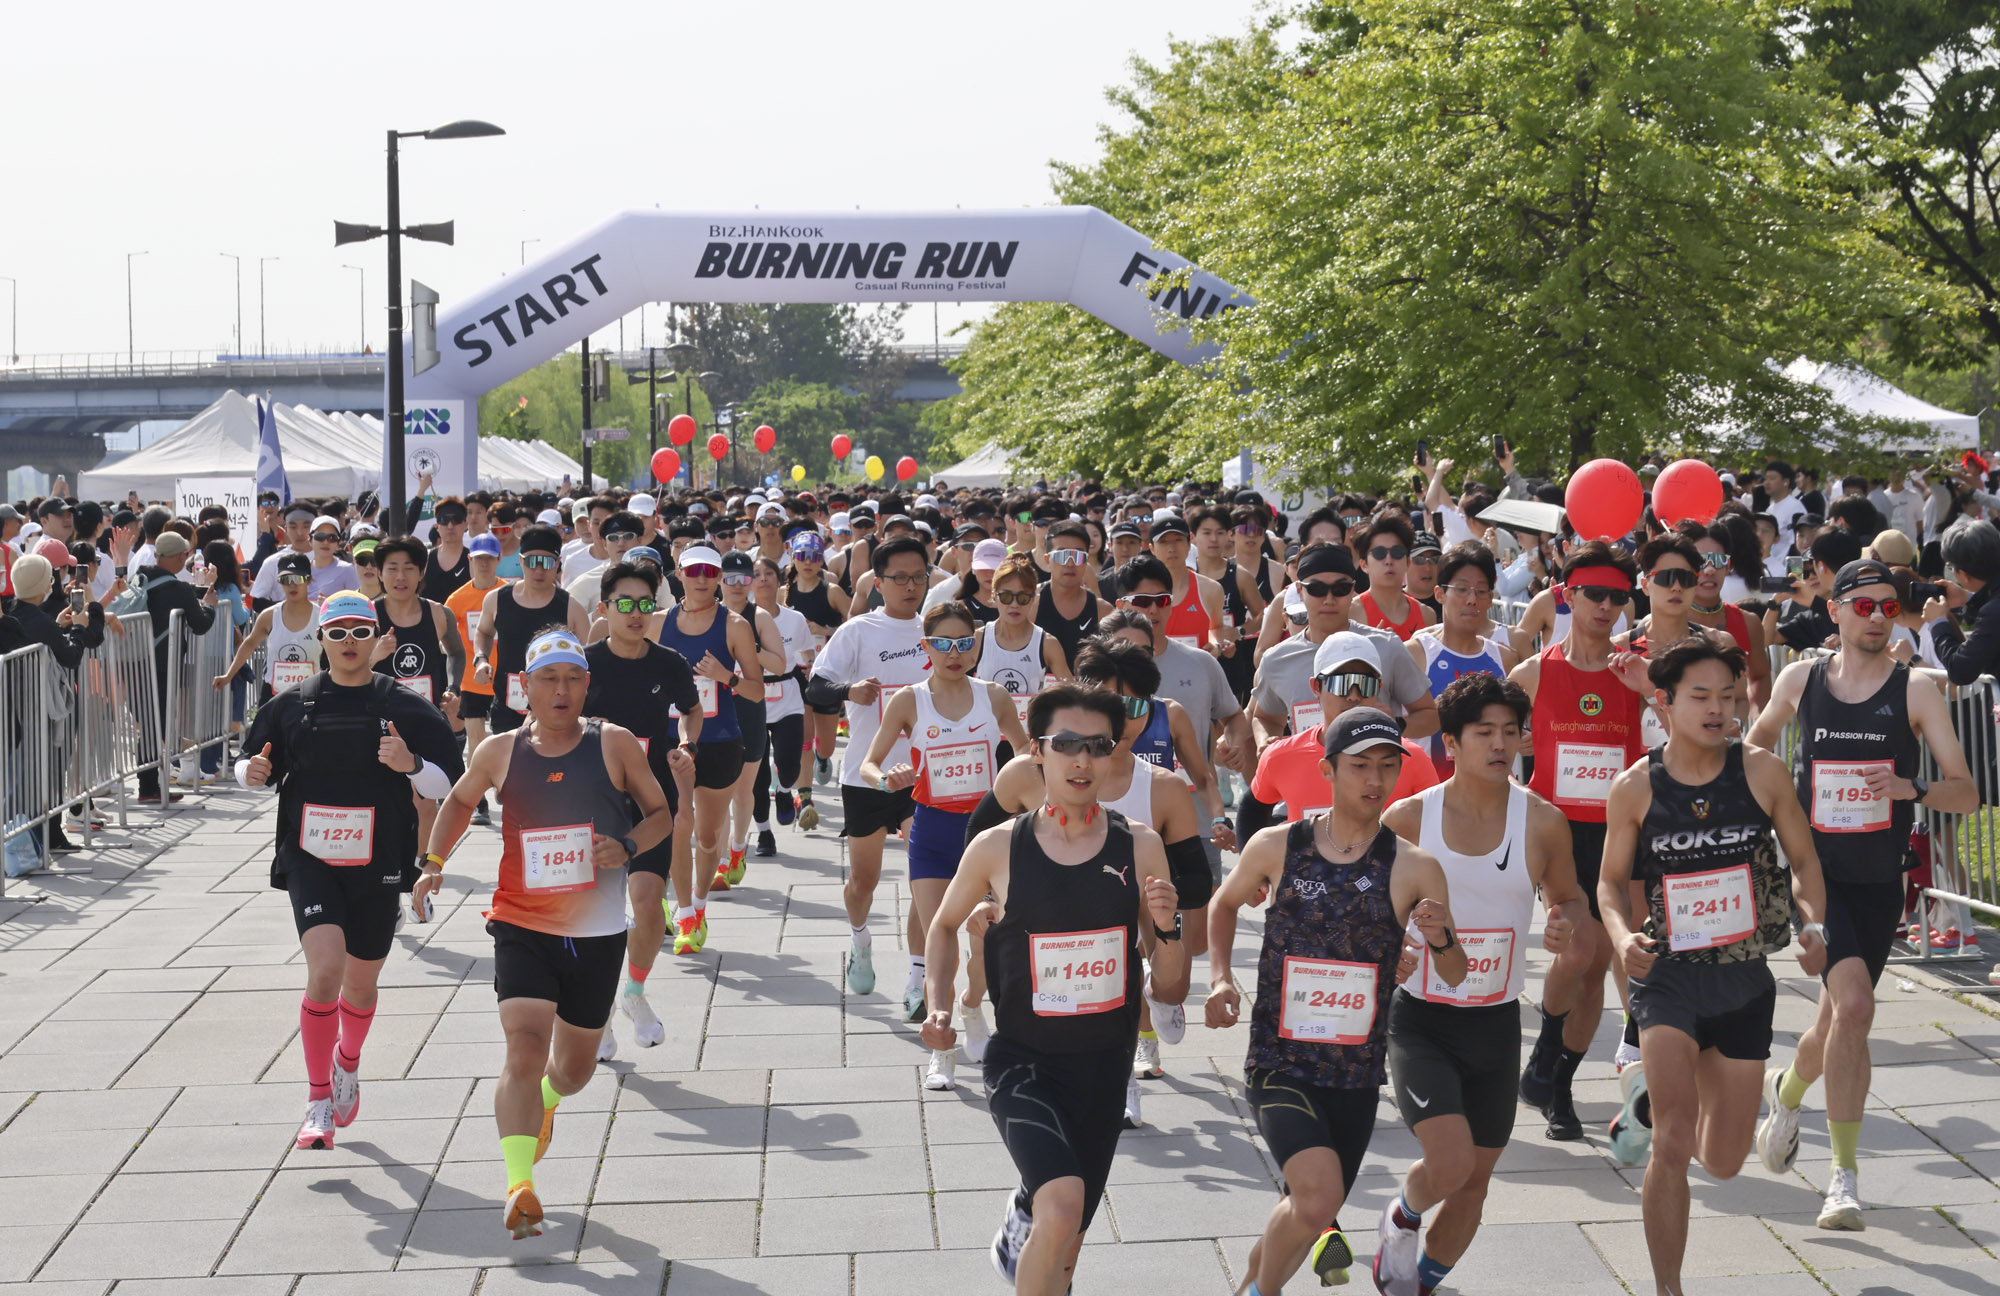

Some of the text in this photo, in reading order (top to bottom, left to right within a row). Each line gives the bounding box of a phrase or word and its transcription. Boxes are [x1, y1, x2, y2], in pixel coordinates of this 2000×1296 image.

[694, 241, 1020, 279] BURNING RUN
[855, 280, 1006, 292] Casual Running Festival
[453, 253, 608, 368] START
[182, 493, 250, 508] 10km 7km
[879, 649, 917, 662] Burning
[1550, 720, 1606, 733] Kwanghwamun
[1829, 732, 1887, 741] PASSION FIRST
[933, 762, 984, 778] W 3315
[1563, 766, 1618, 780] M 2457
[1822, 790, 1831, 799] M
[309, 828, 363, 840] M 1274
[527, 835, 552, 843] BURNING
[1652, 825, 1760, 853] ROKSF
[542, 849, 584, 866] 1841
[1672, 881, 1703, 890] BURNING
[1677, 894, 1741, 917] M 2411
[1674, 932, 1700, 942] B-152
[1040, 941, 1076, 950] BURNING
[1077, 939, 1095, 947] RUN
[1044, 958, 1116, 979] M 1460
[1467, 957, 1501, 973] 901
[1293, 967, 1328, 977] BURNING
[1039, 993, 1067, 1003] C-240
[1293, 991, 1366, 1010] M 2448
[1299, 1026, 1326, 1034] F-138
